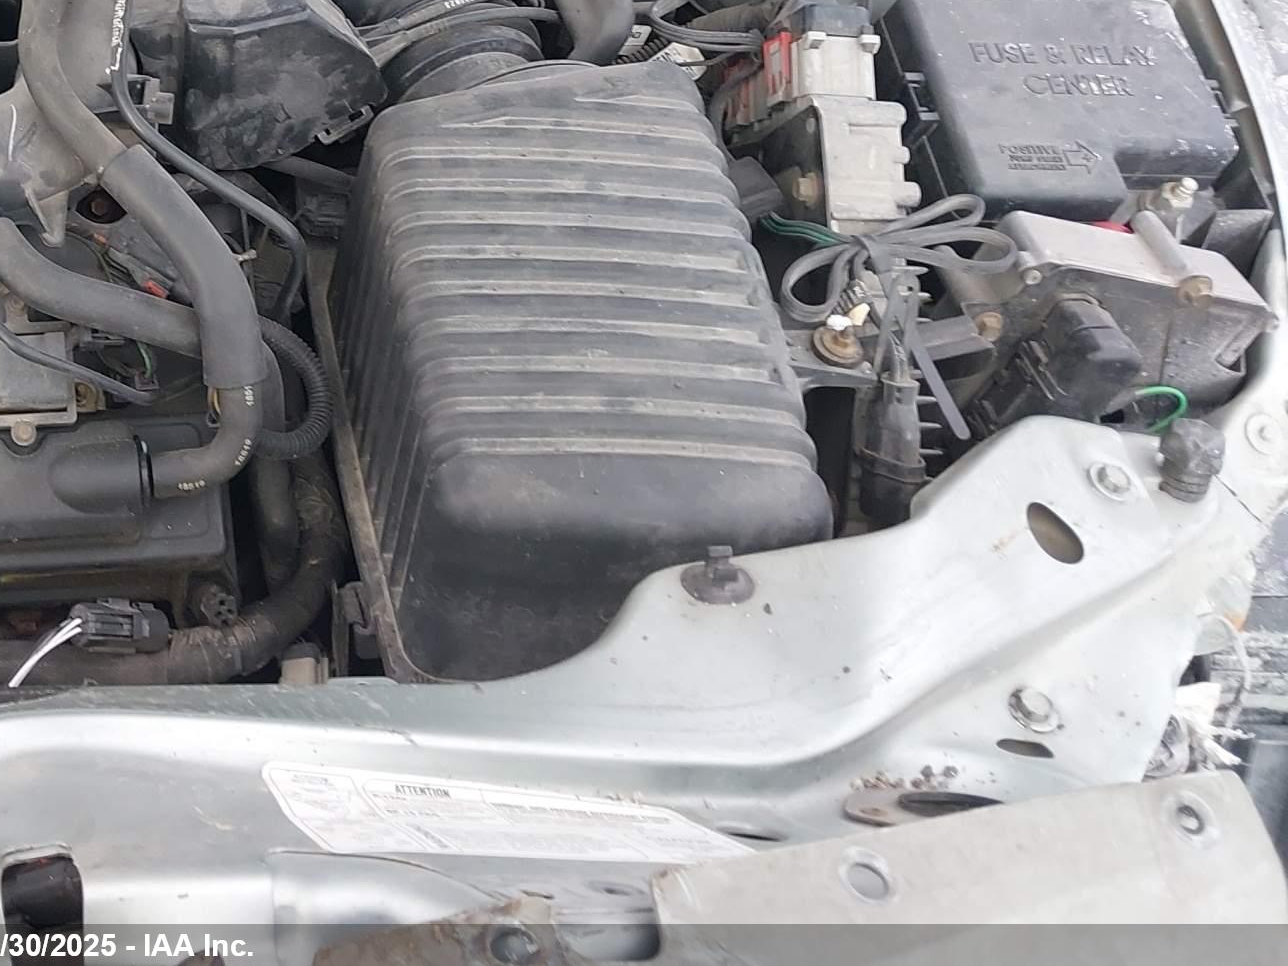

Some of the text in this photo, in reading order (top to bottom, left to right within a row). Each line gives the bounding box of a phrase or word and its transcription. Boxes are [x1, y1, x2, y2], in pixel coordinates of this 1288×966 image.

[968, 42, 1158, 66] FUSE & RELAY
[1023, 74, 1135, 97] CENTER
[395, 784, 453, 799] ATTENTION
